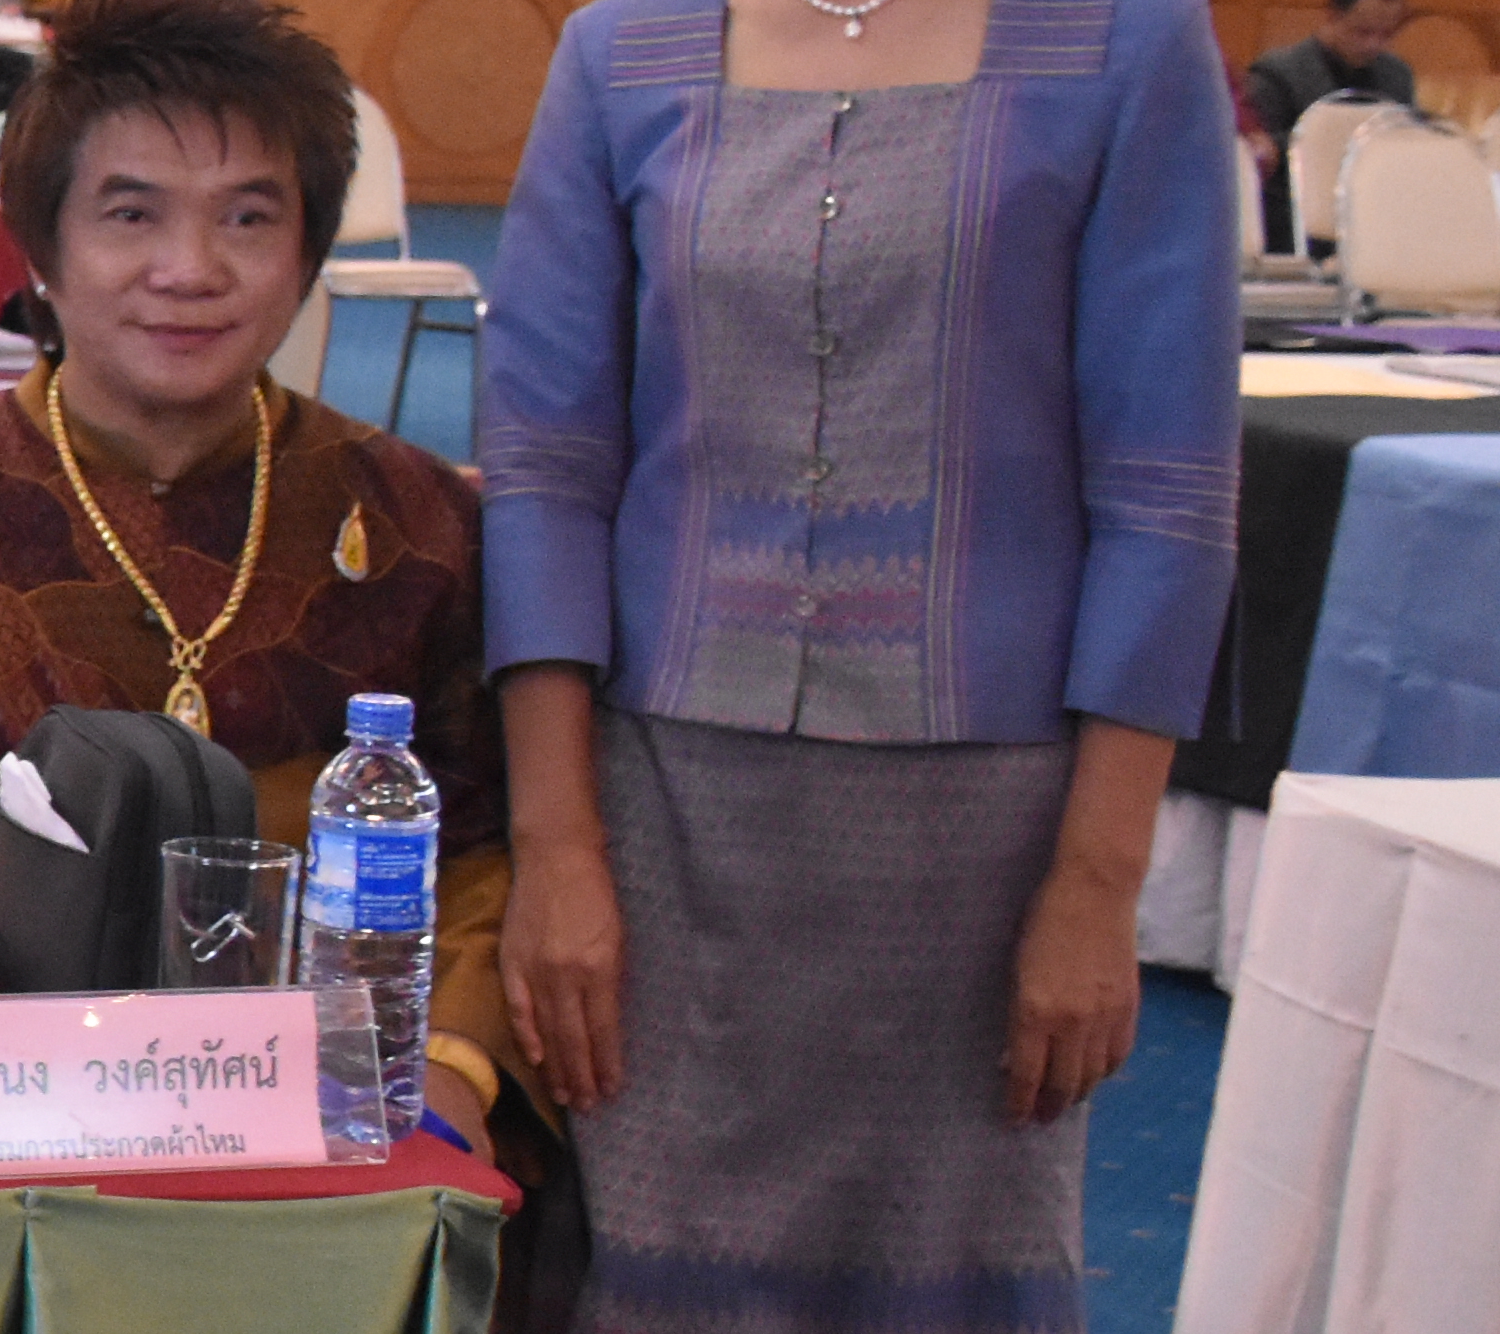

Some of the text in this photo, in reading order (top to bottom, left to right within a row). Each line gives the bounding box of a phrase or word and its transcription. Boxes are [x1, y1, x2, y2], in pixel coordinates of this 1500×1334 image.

[84, 1035, 279, 1109] วงค์สุทัศน์
